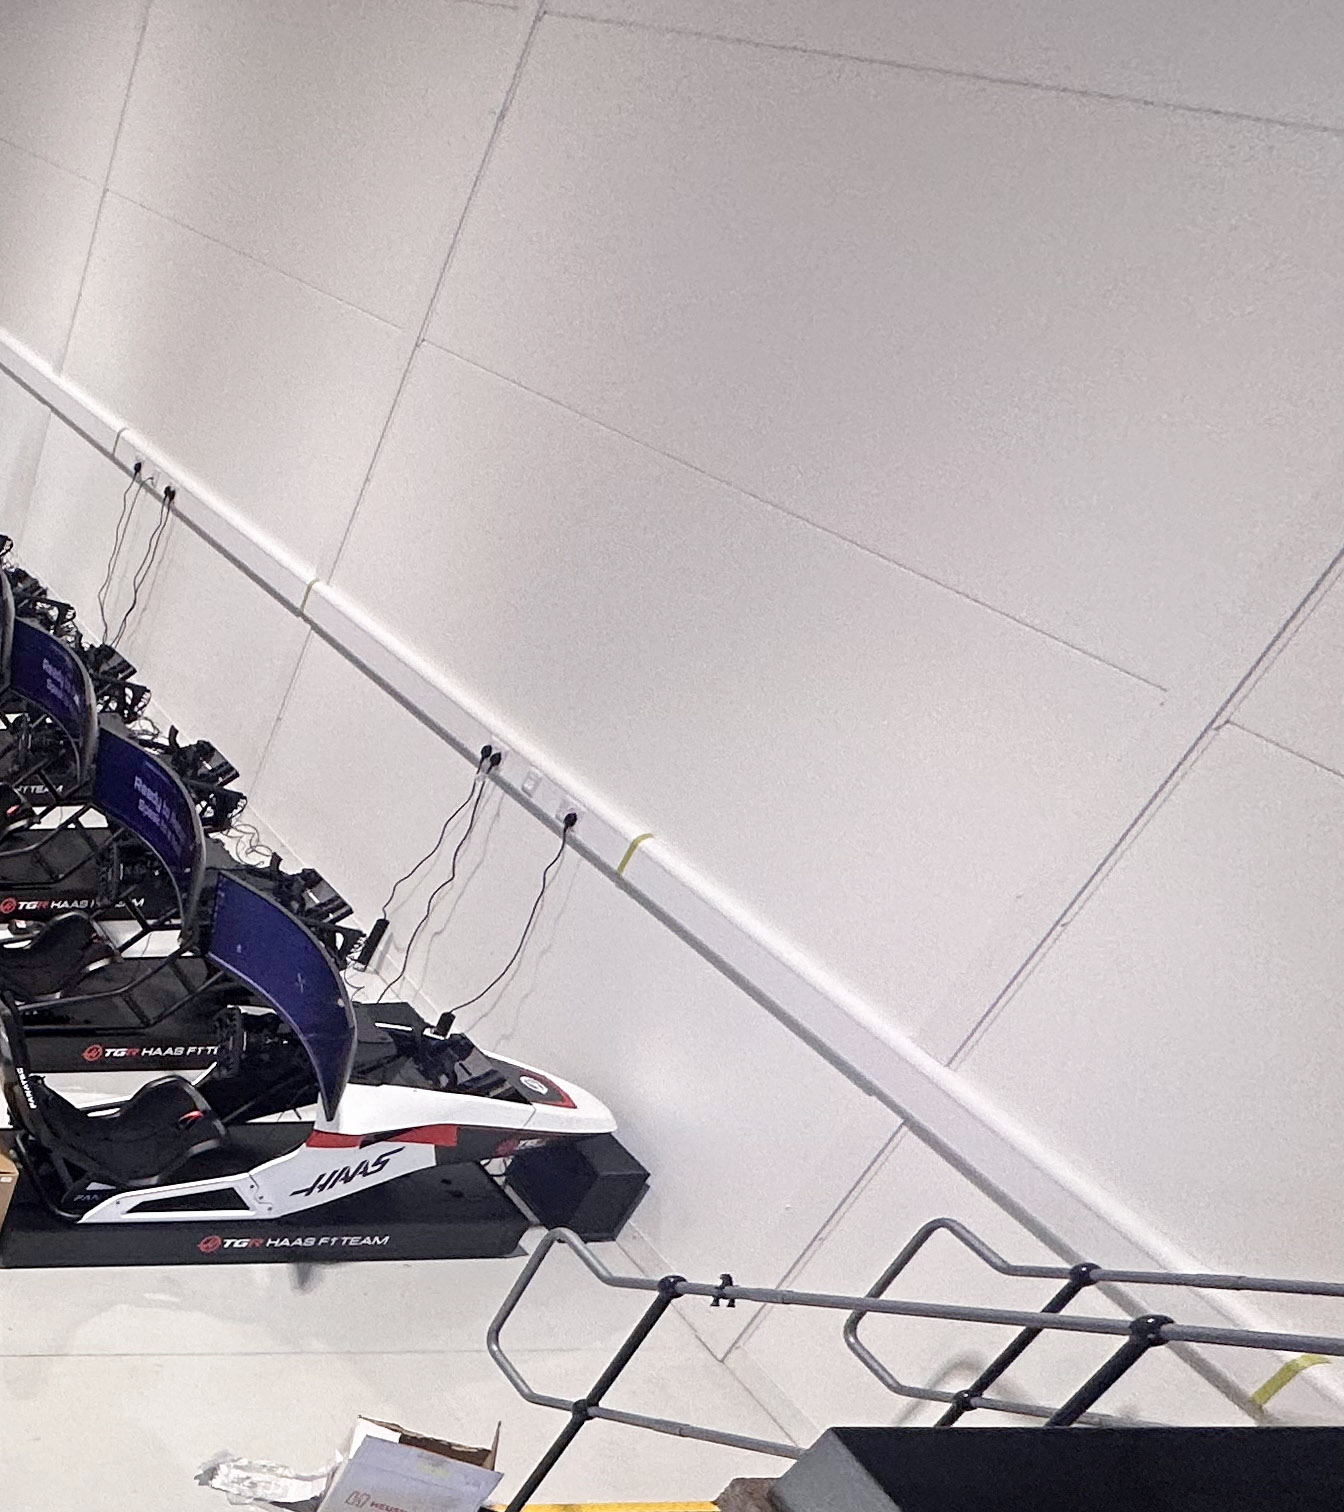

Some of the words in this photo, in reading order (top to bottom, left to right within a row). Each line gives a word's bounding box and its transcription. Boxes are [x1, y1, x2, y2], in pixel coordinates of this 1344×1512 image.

[105, 1047, 140, 1057] TGR
[141, 1047, 185, 1056] HAAS
[290, 1146, 407, 1197] HAAS
[221, 1237, 263, 1248] TGR
[265, 1236, 314, 1247] HAAS
[317, 1236, 339, 1246] F1
[340, 1235, 390, 1246] TEAM
